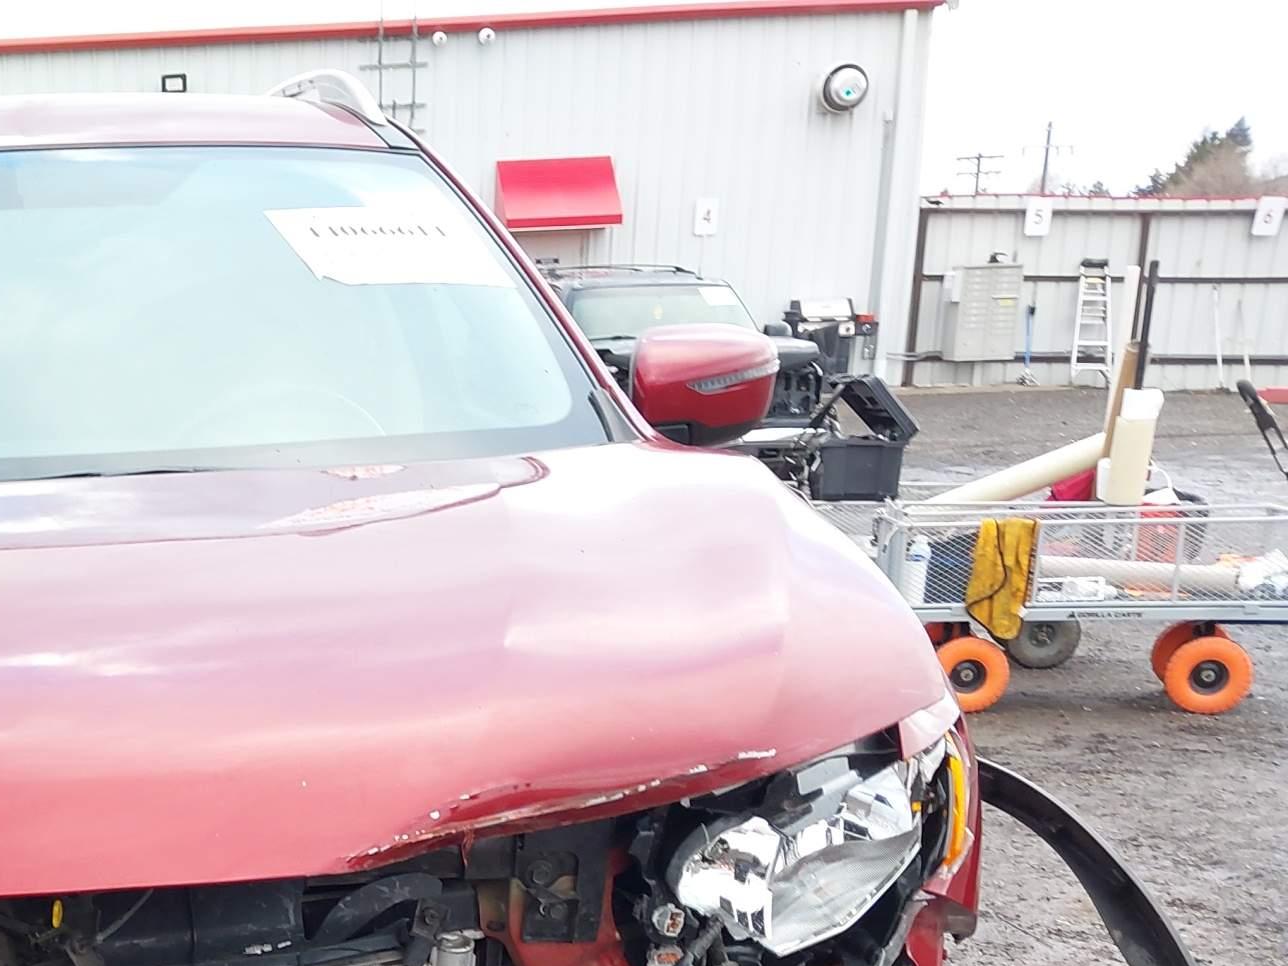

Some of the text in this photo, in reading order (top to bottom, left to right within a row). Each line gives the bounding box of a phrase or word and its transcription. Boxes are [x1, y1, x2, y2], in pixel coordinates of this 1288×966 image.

[700, 208, 712, 224] 4
[1032, 208, 1044, 225] 5
[1262, 208, 1274, 225] 6
